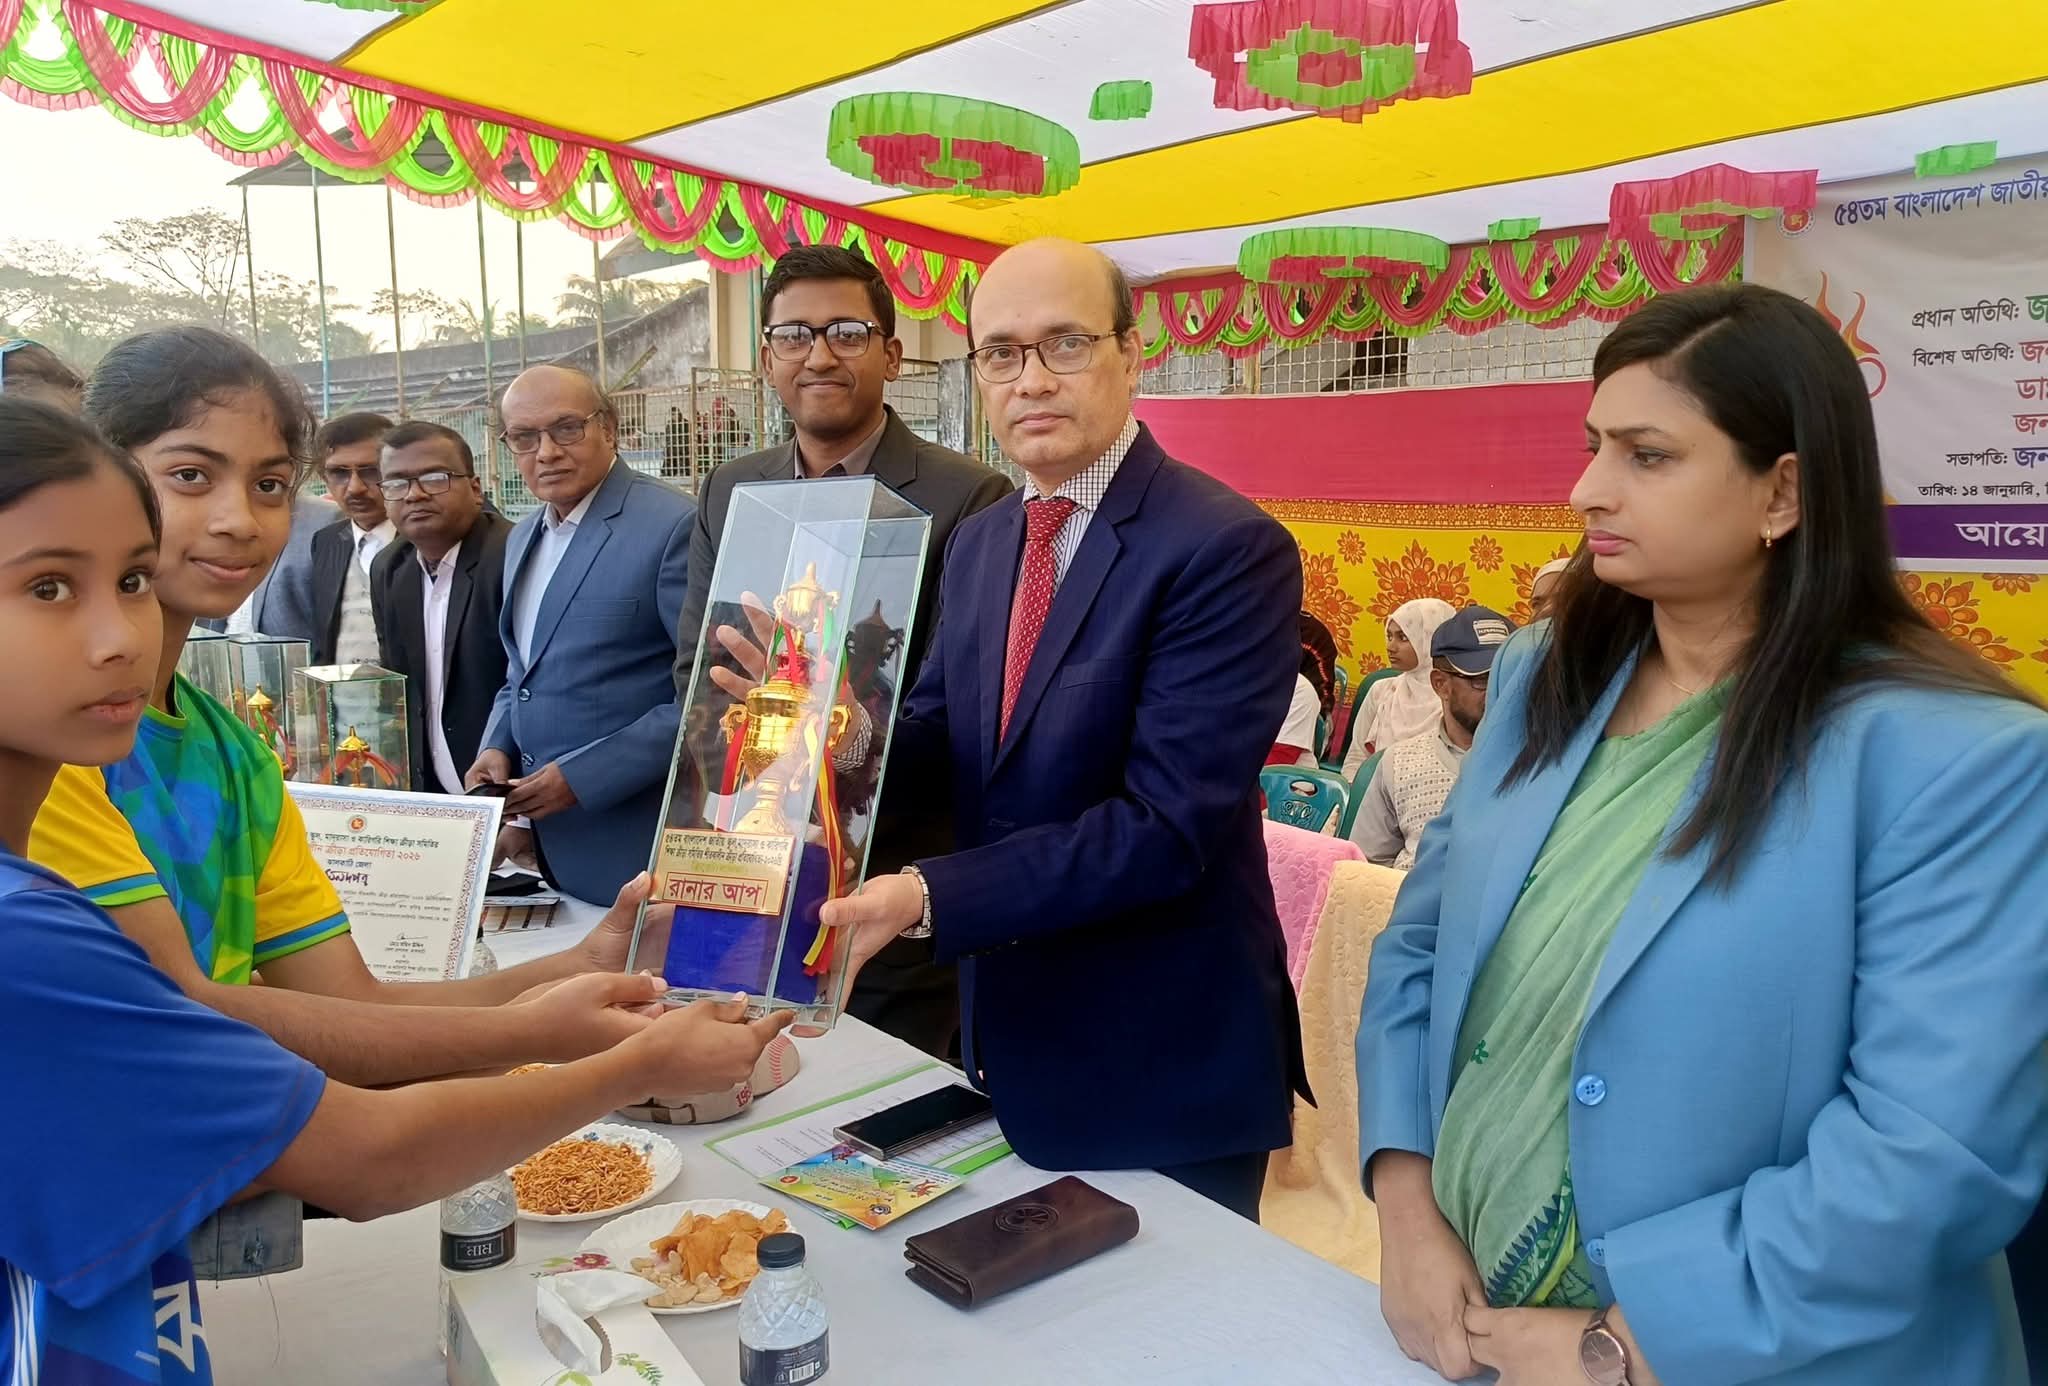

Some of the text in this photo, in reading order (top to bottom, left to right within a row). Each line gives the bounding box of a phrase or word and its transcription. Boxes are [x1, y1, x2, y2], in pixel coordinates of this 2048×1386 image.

[1834, 197, 1889, 226] ৫৪তম
[1893, 183, 1986, 219] বাংলাদেশ
[1912, 309, 1956, 328] প্রধান
[1912, 348, 1957, 366] বিশেষ
[1962, 486, 1978, 496] ১৪
[669, 878, 762, 906] রানার আপ
